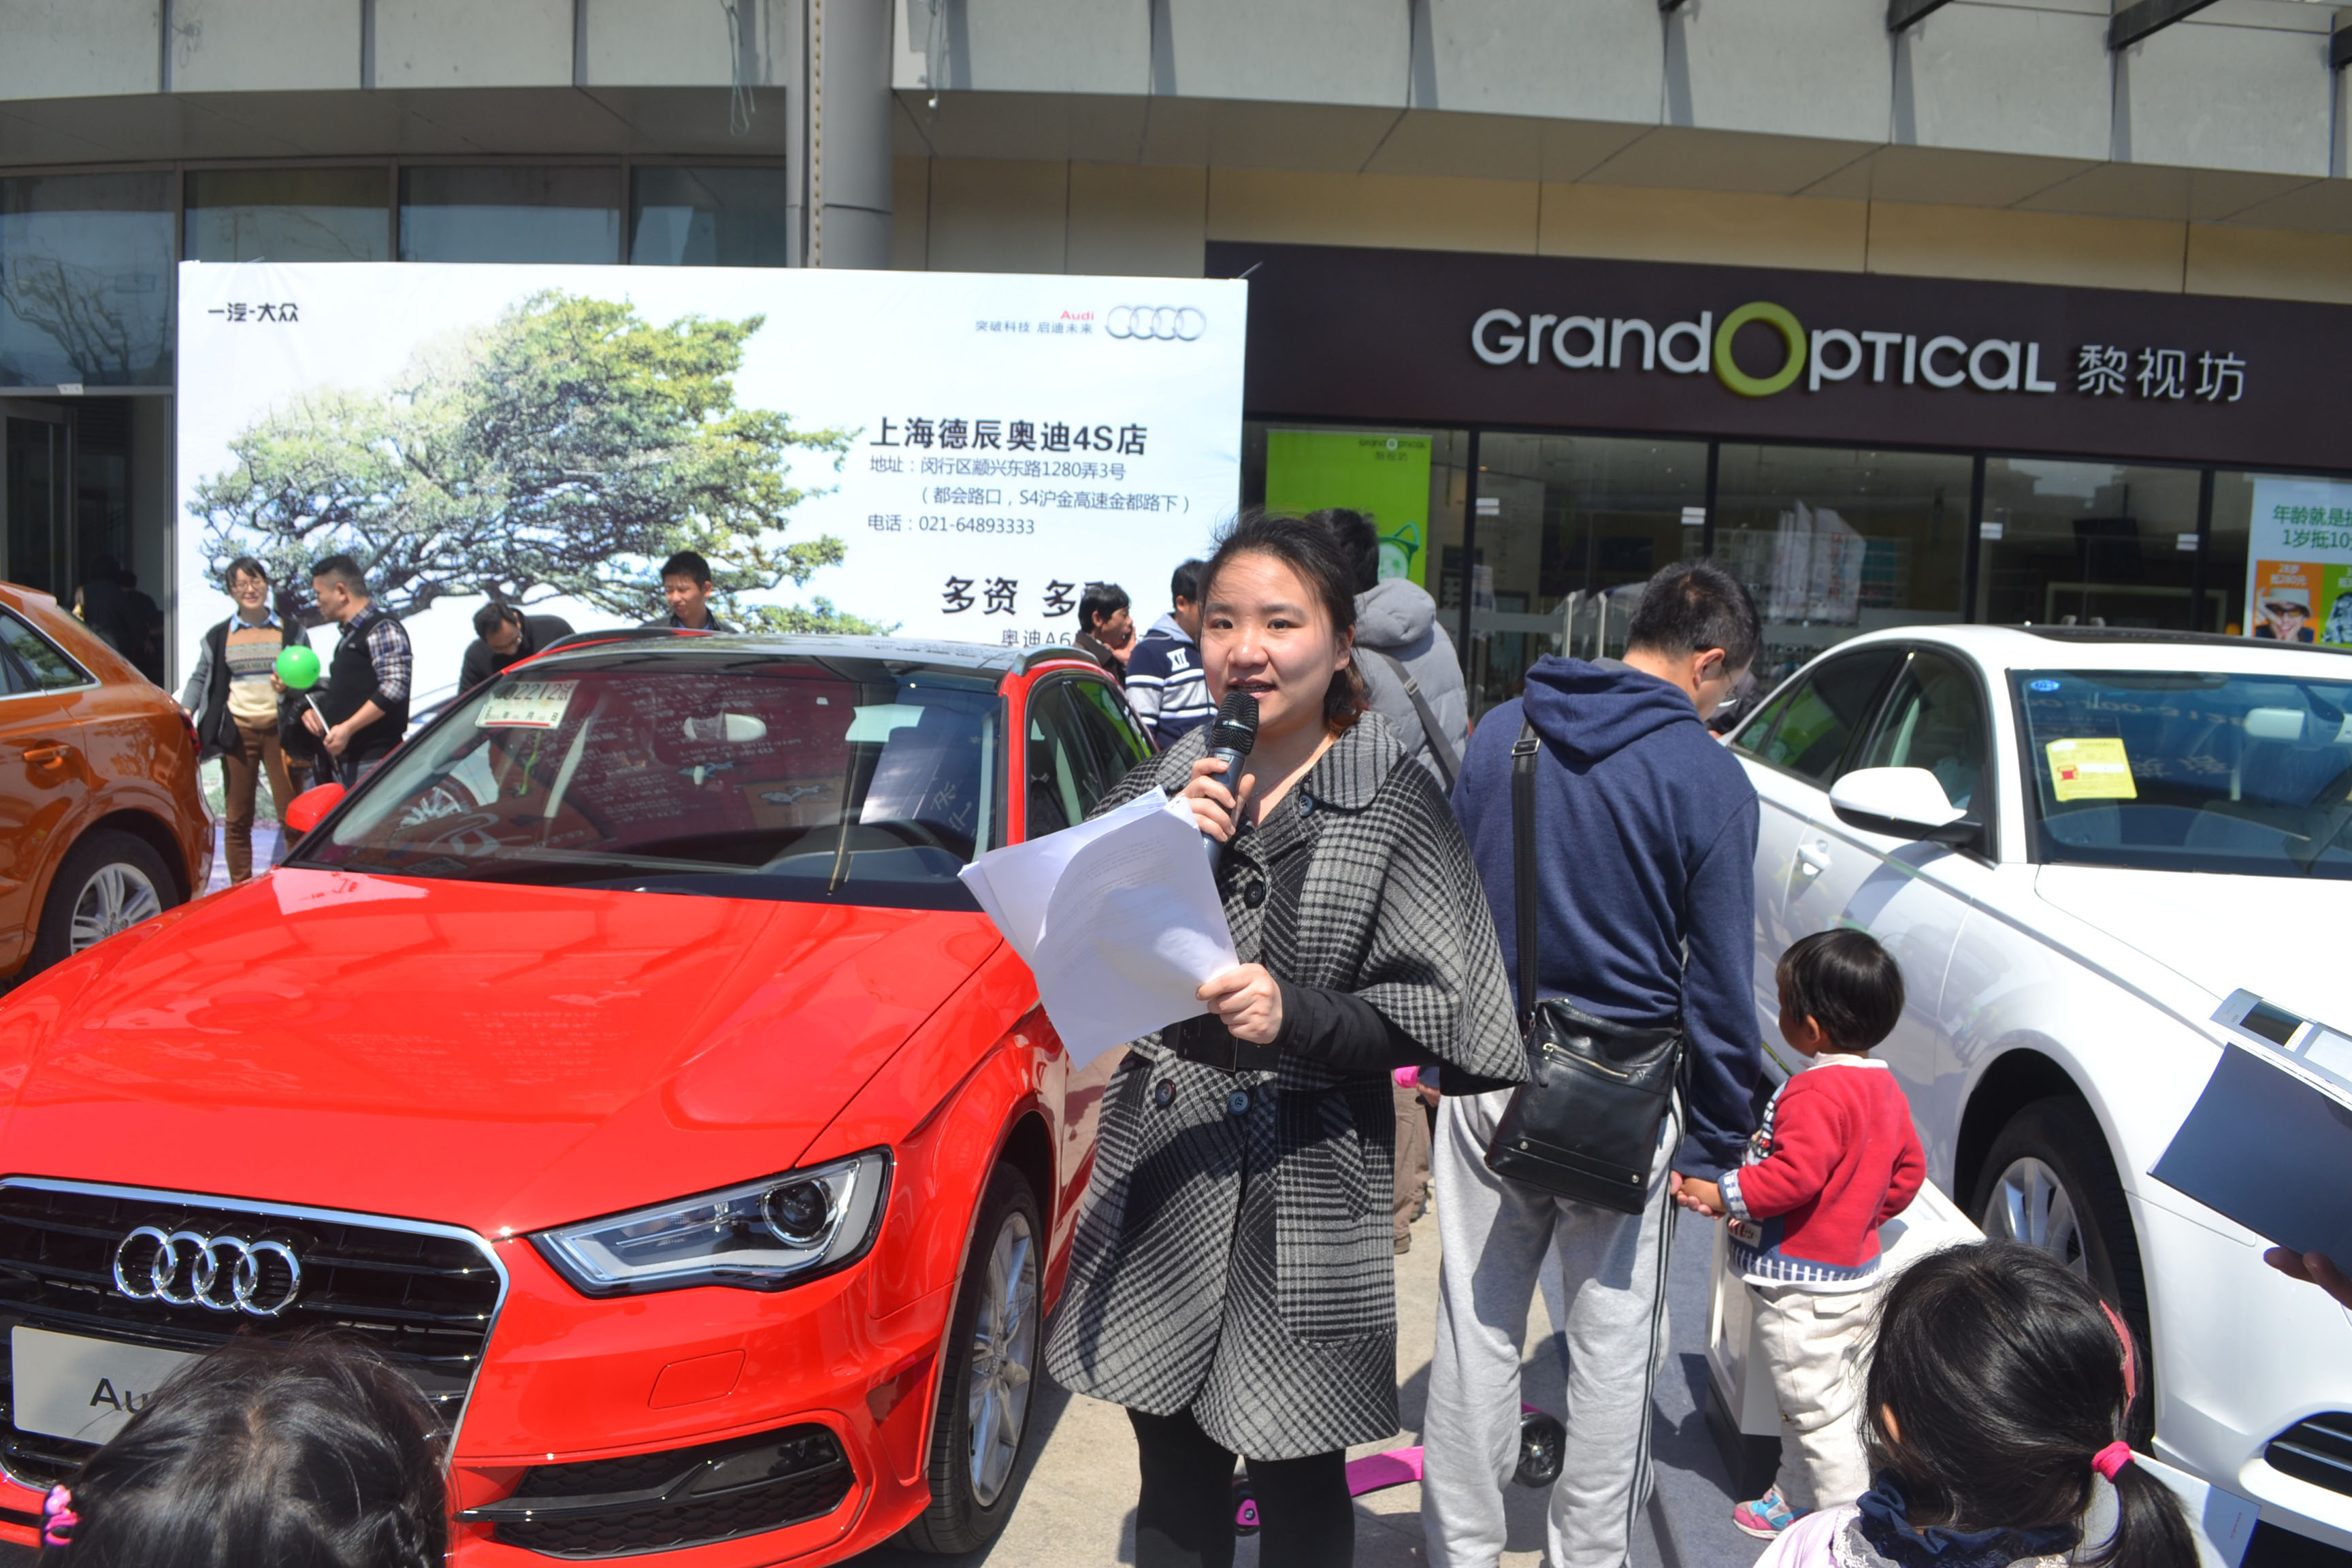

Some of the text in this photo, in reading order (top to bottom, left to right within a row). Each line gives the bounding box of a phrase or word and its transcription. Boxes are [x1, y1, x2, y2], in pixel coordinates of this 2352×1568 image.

[208, 302, 299, 323] 一汽-大众
[1060, 310, 1094, 321] Audi
[2078, 344, 2246, 402] 黎视坊
[870, 416, 1147, 455] 上海德辰奥迪4S店
[2283, 529, 2352, 550] 1岁抵10
[90, 1377, 148, 1414] Au
